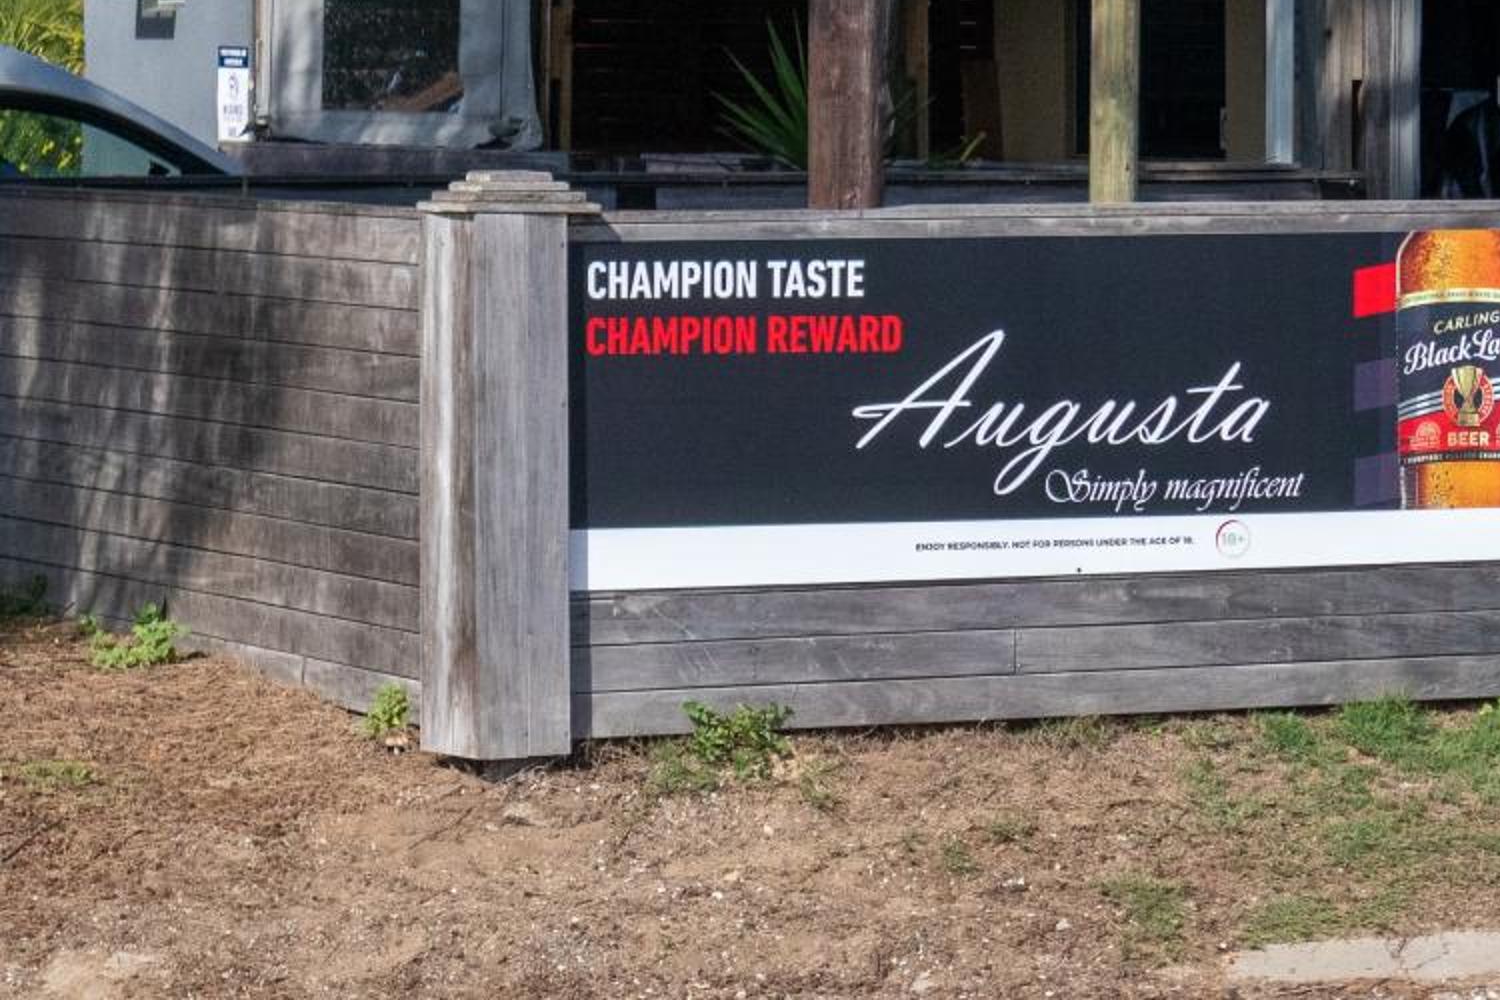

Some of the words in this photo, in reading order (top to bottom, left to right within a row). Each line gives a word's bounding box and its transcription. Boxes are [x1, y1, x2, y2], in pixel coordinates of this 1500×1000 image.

[587, 260, 758, 299] CHAMPION
[767, 259, 865, 298] TASTE
[585, 314, 758, 356] CHAMPION
[767, 313, 903, 354] REWARD
[1433, 310, 1500, 335] CARLING
[1403, 334, 1473, 375] Black
[852, 329, 1271, 496] Augusta
[1447, 430, 1490, 447] BEER
[1044, 468, 1157, 512] Simply
[1163, 465, 1305, 511] magnificent
[915, 543, 946, 552] ENJOY
[1012, 540, 1031, 549] NOT
[1033, 539, 1051, 548] FOR
[1053, 538, 1095, 548] PERSONS
[1096, 537, 1128, 547] UNDER
[1130, 537, 1146, 546] THE
[1168, 537, 1181, 545] OF
